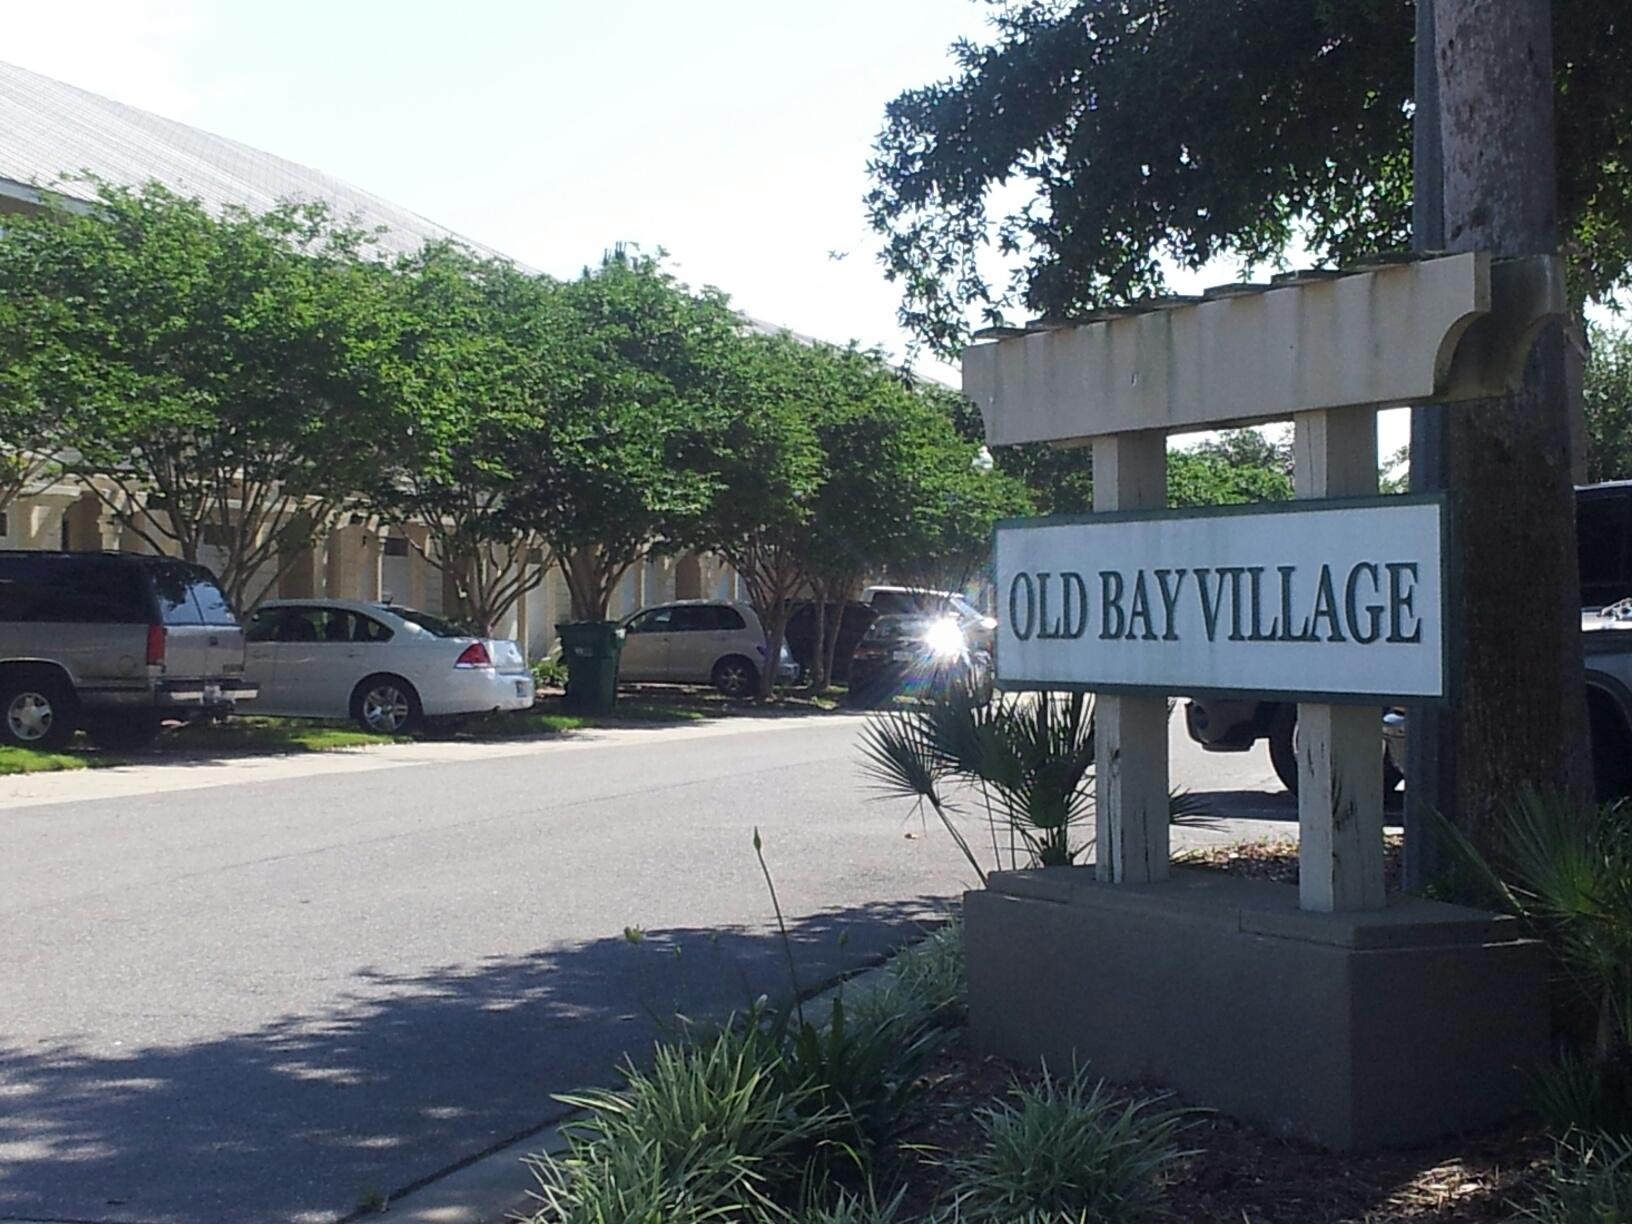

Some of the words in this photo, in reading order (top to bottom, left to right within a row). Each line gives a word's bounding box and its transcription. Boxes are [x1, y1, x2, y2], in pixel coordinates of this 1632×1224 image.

[1009, 571, 1088, 641] OLD
[1099, 569, 1187, 642] BAY
[1193, 561, 1422, 645] VILLAGE
